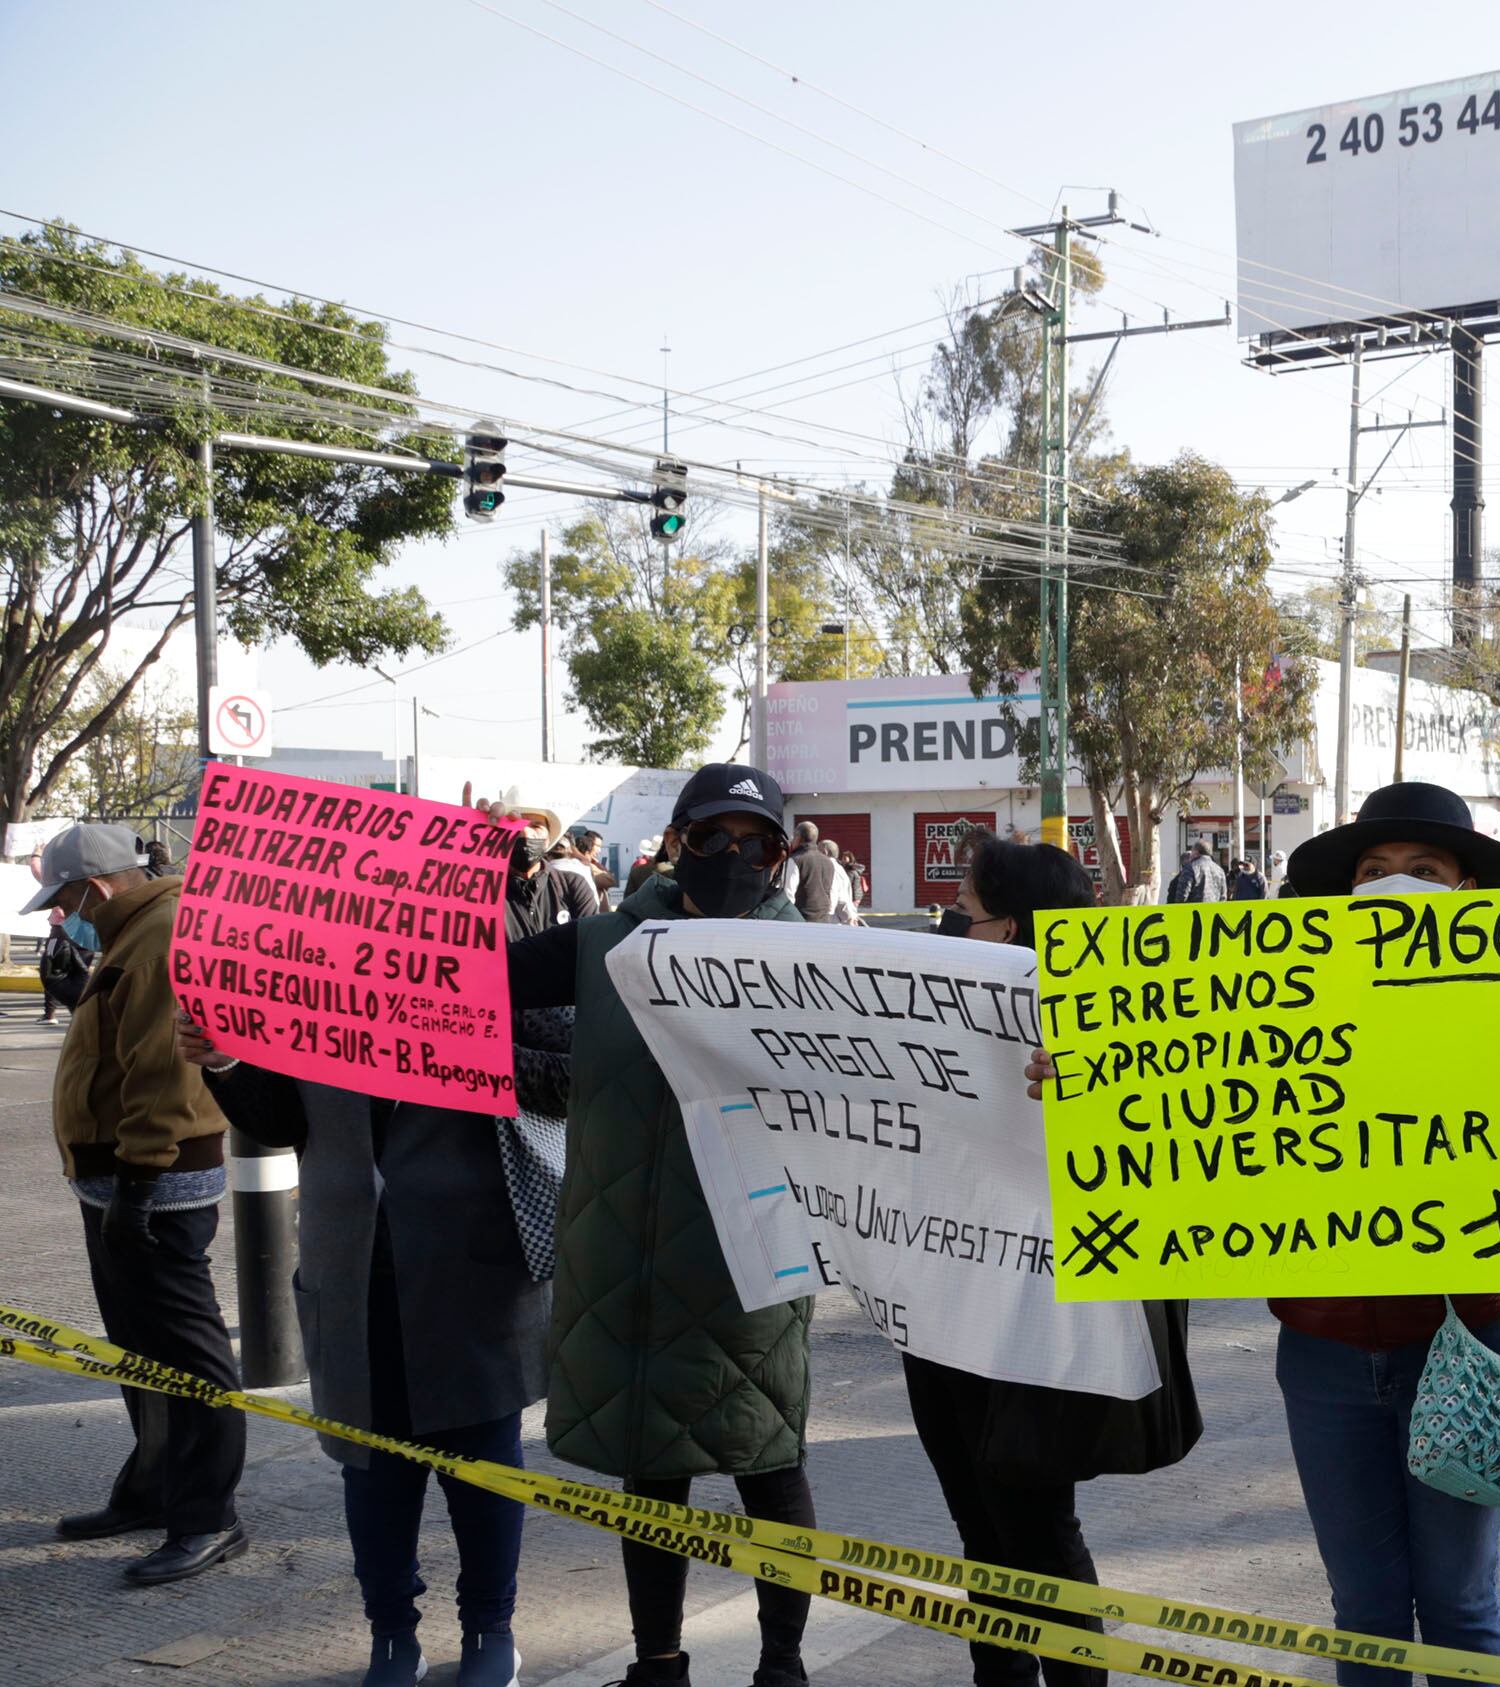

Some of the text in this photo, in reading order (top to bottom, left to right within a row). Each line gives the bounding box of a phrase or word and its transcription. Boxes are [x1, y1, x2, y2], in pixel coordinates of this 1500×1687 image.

[1306, 124, 1326, 164] 2
[1339, 113, 1384, 156] 40
[1399, 102, 1443, 147] 53
[766, 695, 818, 713] MPEÑO
[766, 720, 804, 736] ENTA
[766, 743, 818, 761] OMPRA
[766, 767, 838, 785] PARTADO
[204, 775, 413, 842] EJIDATARIOS
[729, 787, 763, 801] adidas
[184, 862, 223, 897] LA
[194, 817, 347, 879] BALTAZAR
[415, 858, 504, 905] EXIGEN
[176, 906, 208, 941] DE
[211, 914, 249, 951] Las
[354, 942, 374, 976] 2
[383, 951, 461, 993] SUR
[1044, 908, 1333, 977] EXIGIMOS
[410, 1015, 498, 1038] CAMACHO E.
[441, 1003, 497, 1021] CARLOS
[1042, 965, 1316, 1038] TERRENOS
[214, 1003, 271, 1045] SUR
[290, 1018, 318, 1053] 24
[324, 1025, 378, 1069] SUR
[751, 1028, 978, 1100] PAGO DE
[1052, 1023, 1357, 1100] EXPROPIADOS
[747, 1087, 922, 1153] CALLES
[1118, 1073, 1345, 1132] CIUDAD
[1160, 1200, 1446, 1264] APOYANOS
